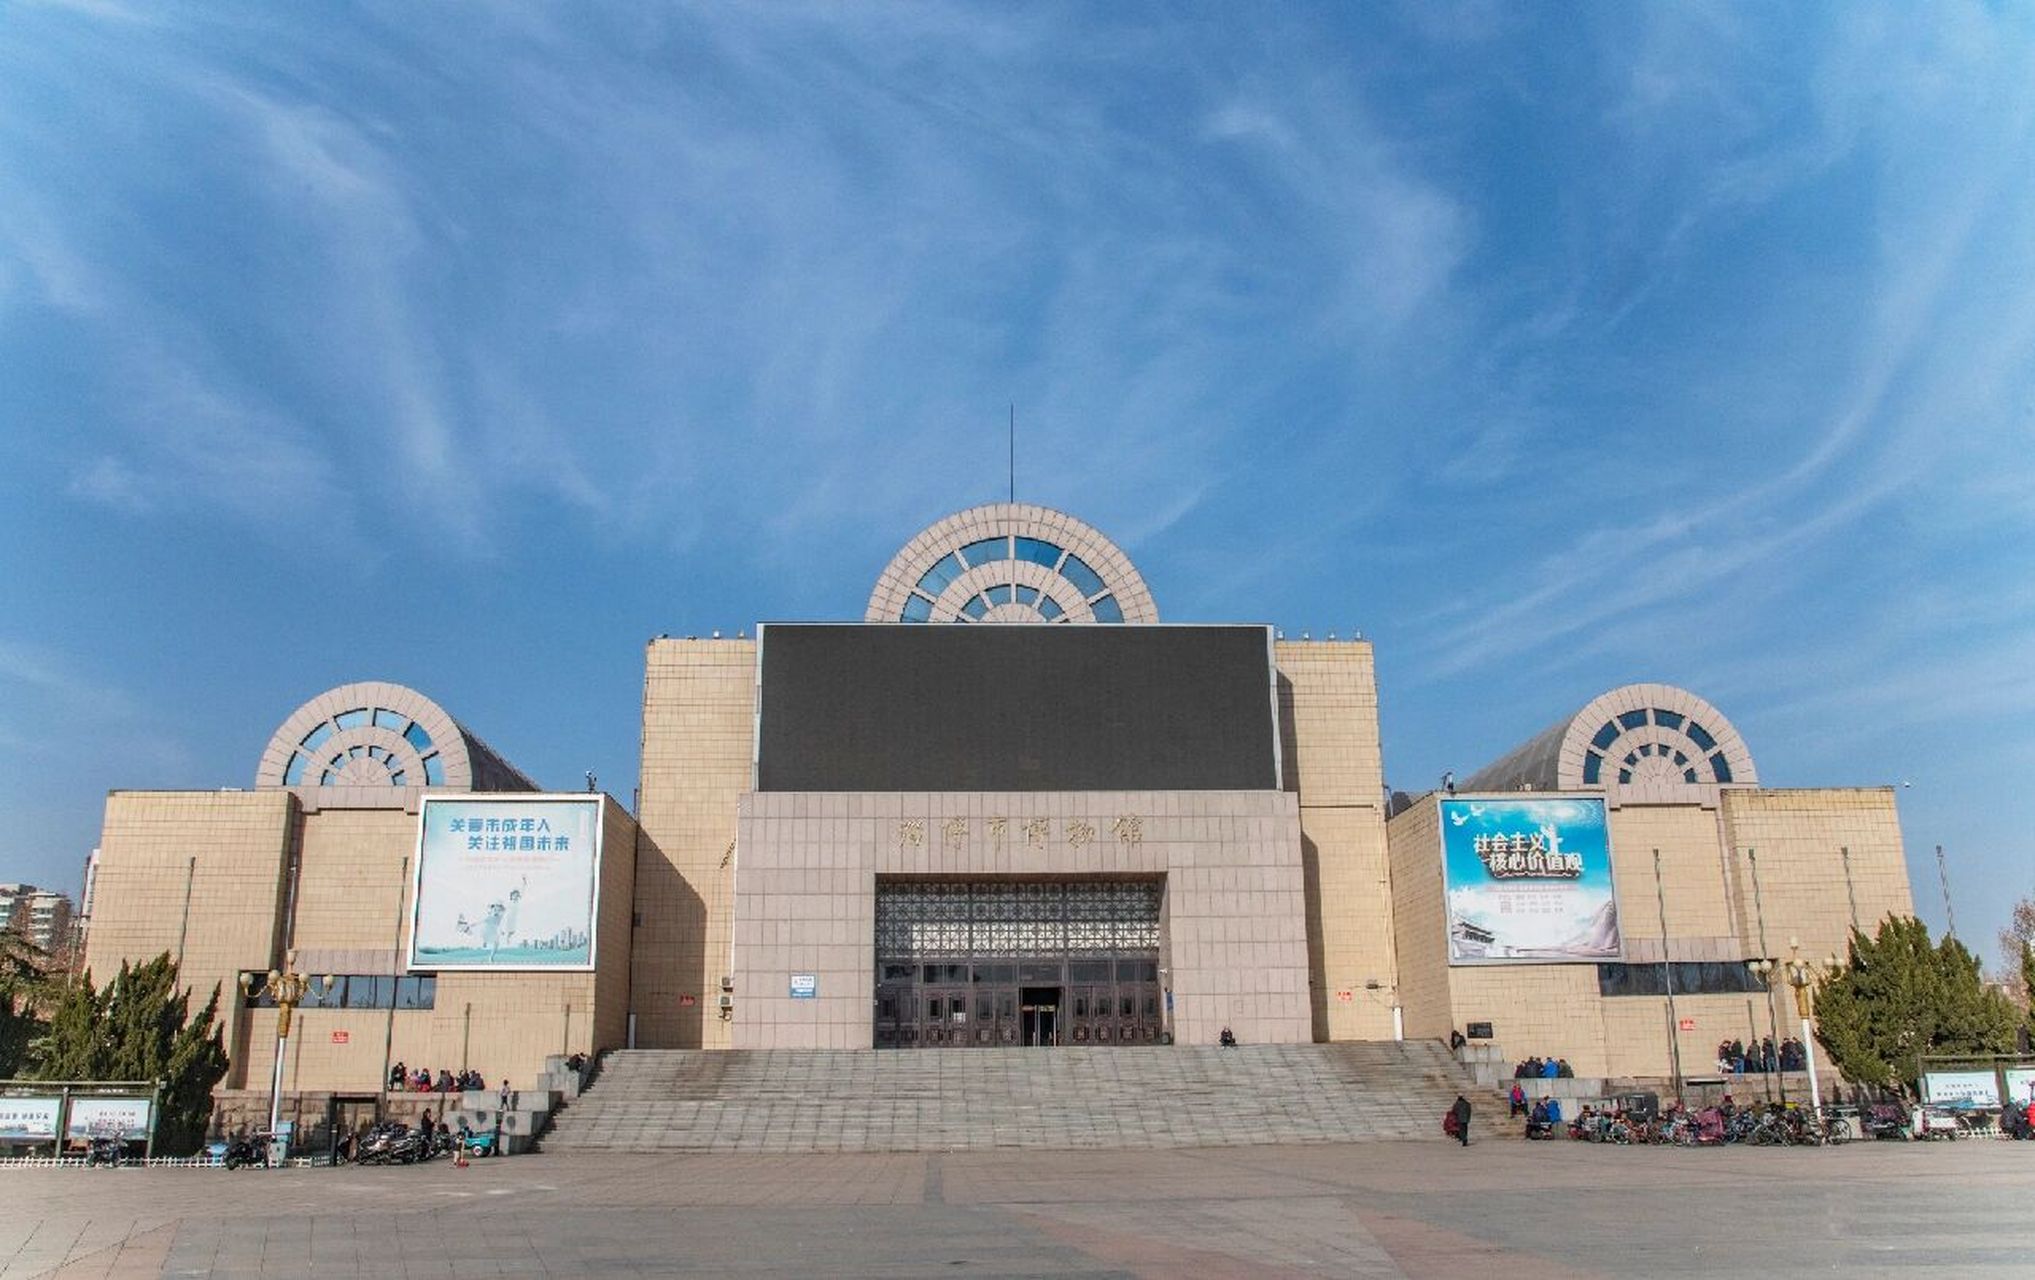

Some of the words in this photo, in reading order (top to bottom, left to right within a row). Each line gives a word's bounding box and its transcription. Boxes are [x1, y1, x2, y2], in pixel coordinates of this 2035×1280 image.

[449, 818, 551, 833] 关爱未成年人
[468, 836, 570, 851] 关注祖国未来
[1474, 832, 1547, 853] 社会主义
[1490, 852, 1584, 872] 核心价值观
